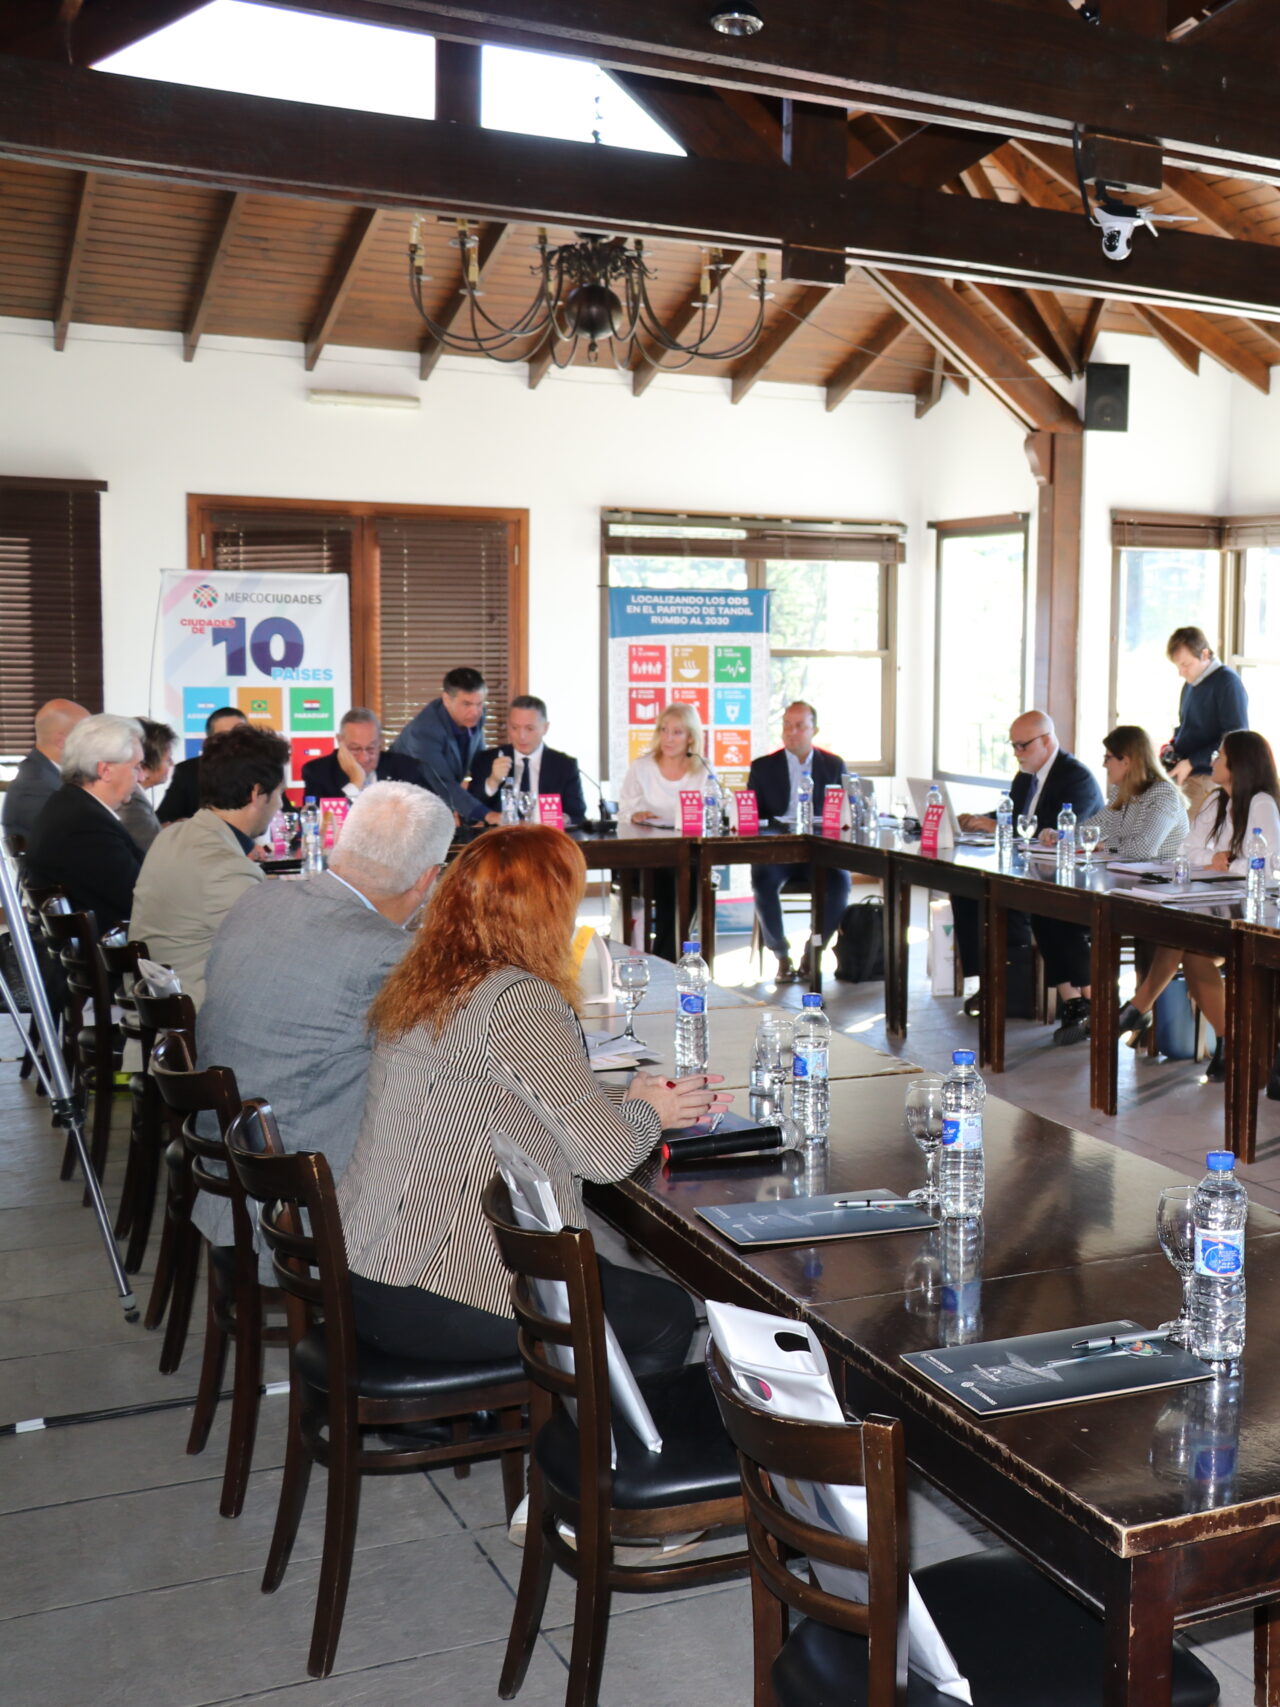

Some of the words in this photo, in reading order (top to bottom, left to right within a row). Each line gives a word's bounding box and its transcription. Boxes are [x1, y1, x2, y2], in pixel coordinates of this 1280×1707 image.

[224, 592, 322, 605] MERCOCIUDADES
[631, 595, 704, 605] LOCALIZANDO
[706, 597, 726, 605] LOS
[727, 597, 749, 605] ODS
[626, 605, 641, 614] EN
[643, 606, 655, 614] EL
[657, 606, 700, 615] PARTIDO
[702, 607, 716, 615] DE
[718, 608, 753, 616] TANDIL
[180, 619, 235, 628] CIUDADES
[651, 616, 688, 625] RUMBO
[689, 617, 703, 625] AL
[705, 617, 730, 625] 2030
[212, 617, 304, 677] 10
